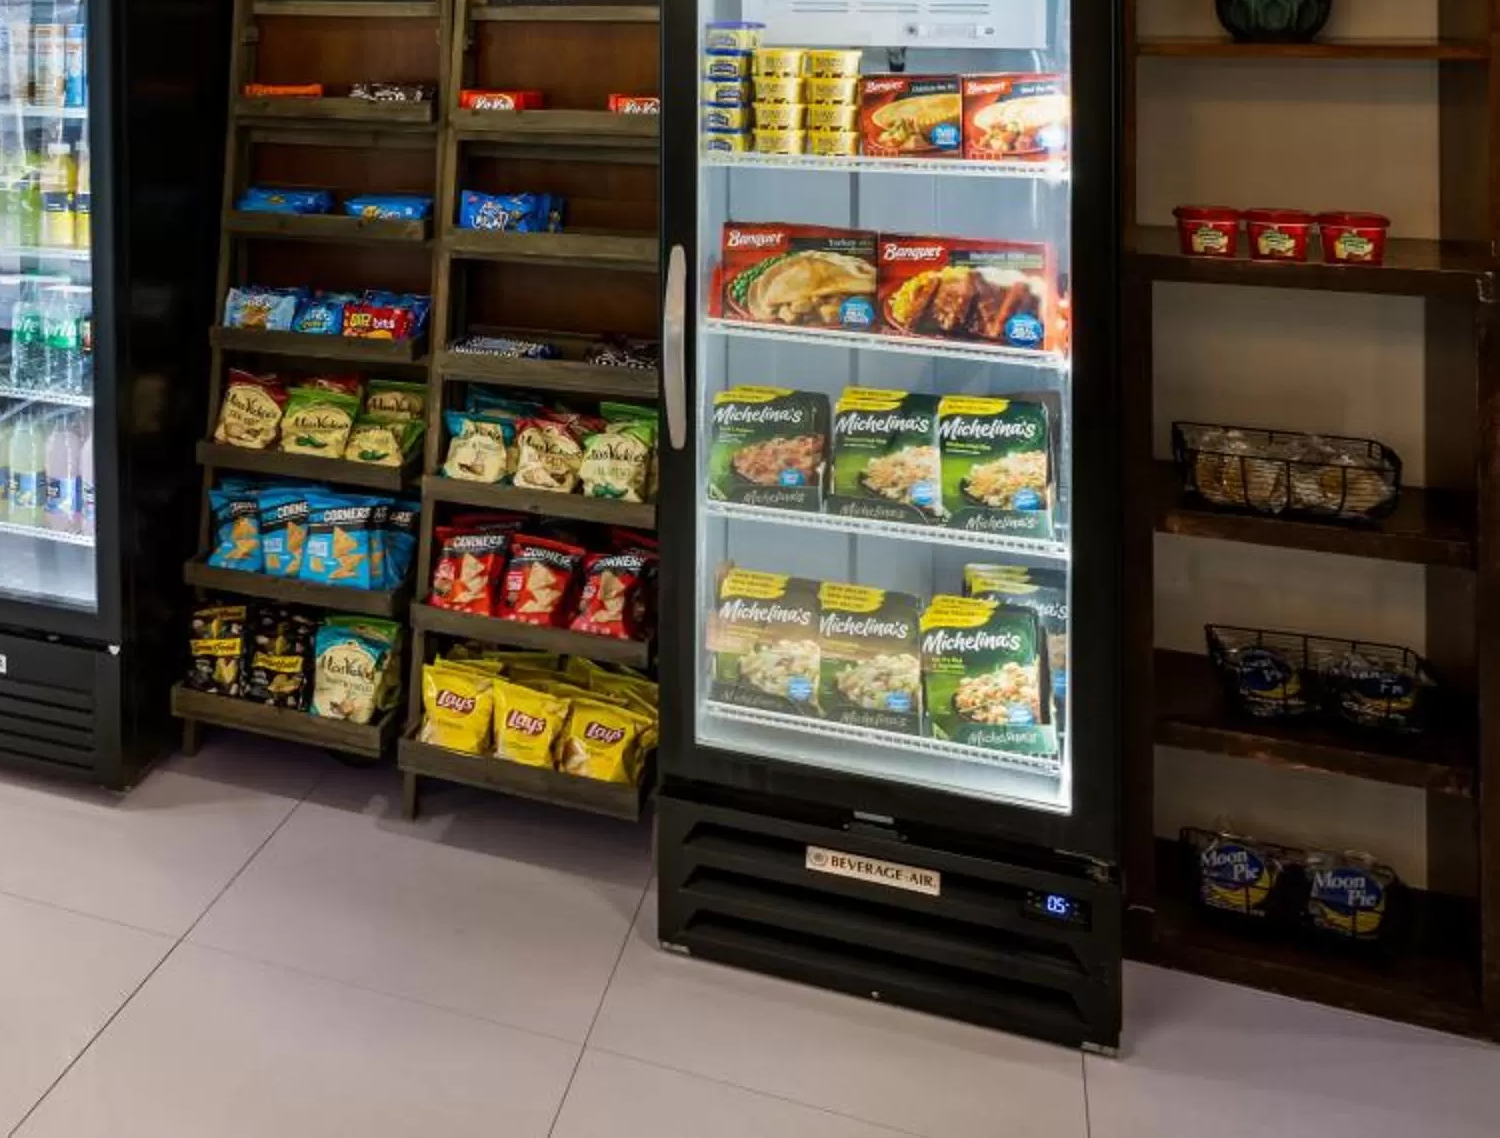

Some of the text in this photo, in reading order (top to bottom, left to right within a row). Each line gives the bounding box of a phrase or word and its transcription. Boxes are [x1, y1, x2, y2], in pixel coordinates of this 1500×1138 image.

[727, 229, 785, 248] Banquet
[883, 243, 945, 261] Banquet
[712, 403, 803, 424] Michelina's
[835, 412, 930, 435] Michelina's
[940, 416, 1037, 440] Michelina's
[276, 502, 309, 519] CORNE
[719, 598, 812, 625] Michelina's
[922, 630, 1021, 654] Michelina's
[1200, 848, 1248, 867] Moon
[831, 855, 933, 888] BEVERAGE-AIR
[1313, 870, 1366, 889] Moon
[1346, 889, 1378, 907] Pie
